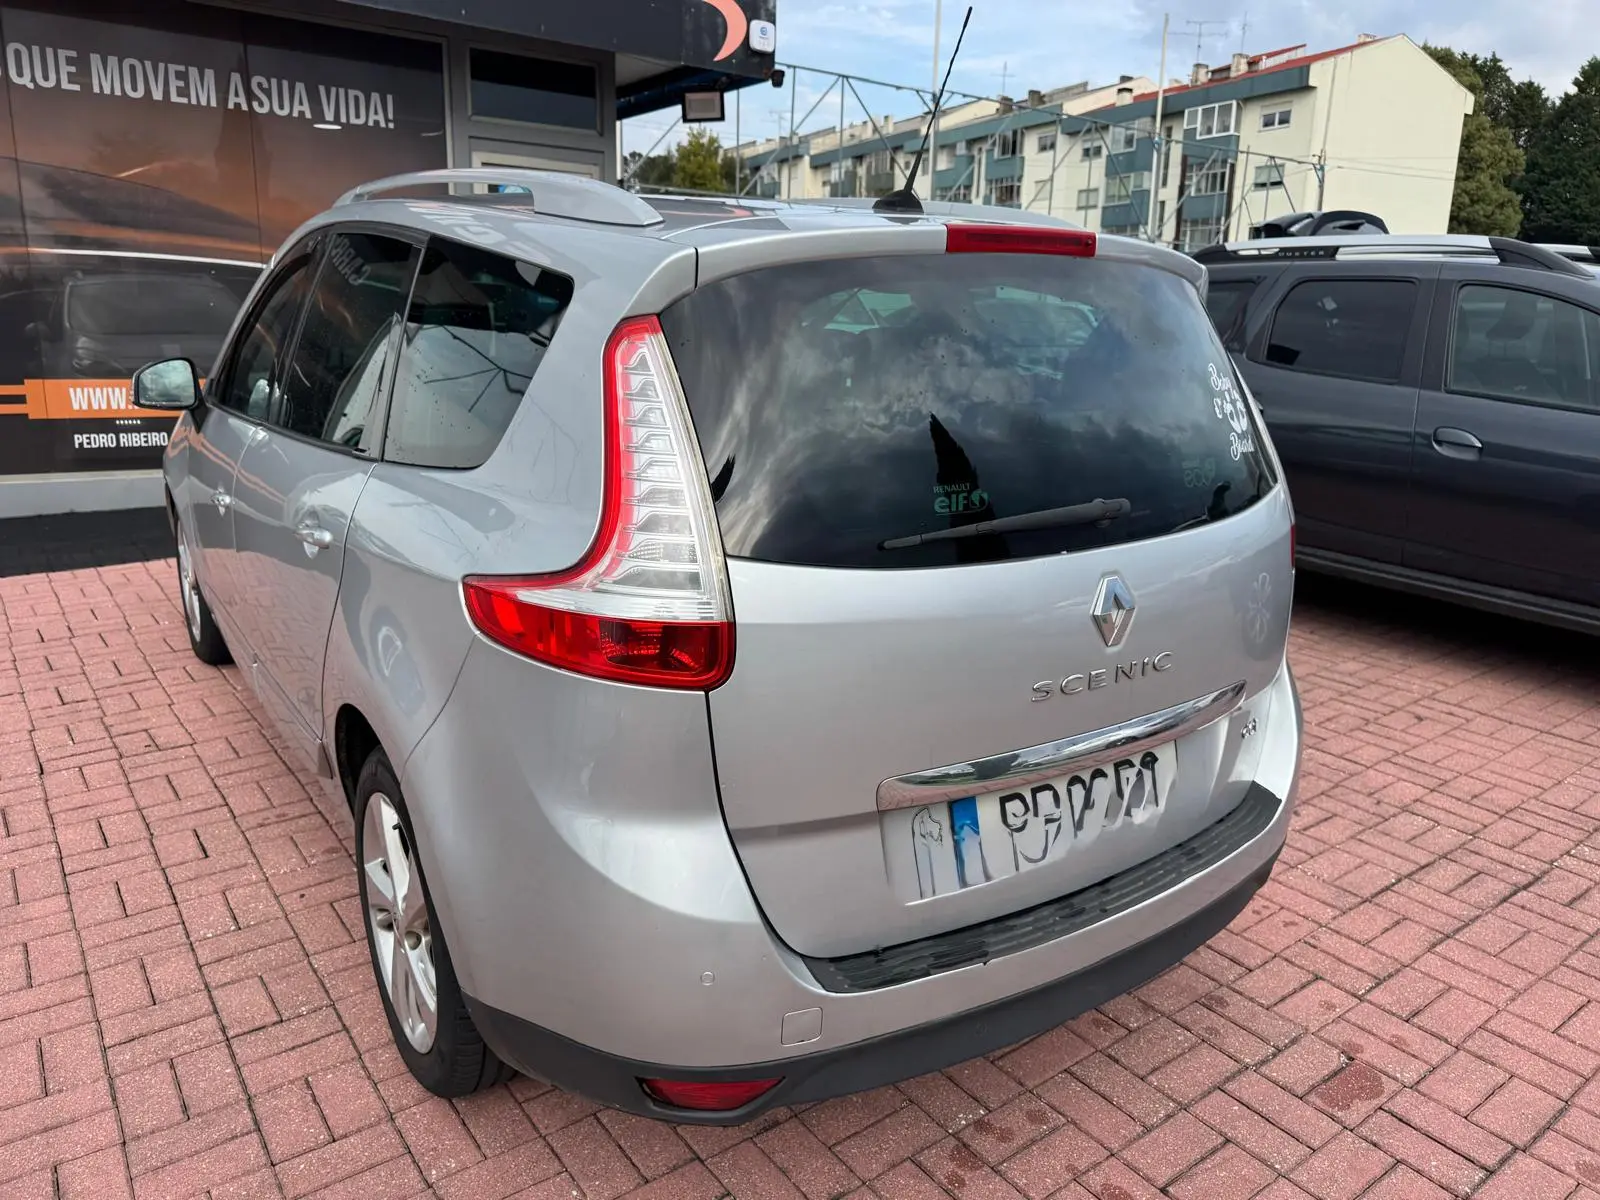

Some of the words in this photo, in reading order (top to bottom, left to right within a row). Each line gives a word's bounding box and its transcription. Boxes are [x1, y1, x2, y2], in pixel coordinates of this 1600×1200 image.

[6, 42, 81, 91] QUE
[89, 52, 217, 107] MOVEM
[227, 72, 249, 111] A
[251, 75, 312, 119] SUA
[318, 84, 395, 129] VIDA!
[74, 433, 117, 449] PEDRO
[119, 432, 169, 447] RIBEIRO
[933, 482, 971, 494] RENAULT
[934, 493, 968, 513] elf
[1031, 651, 1173, 702] SCENIC
